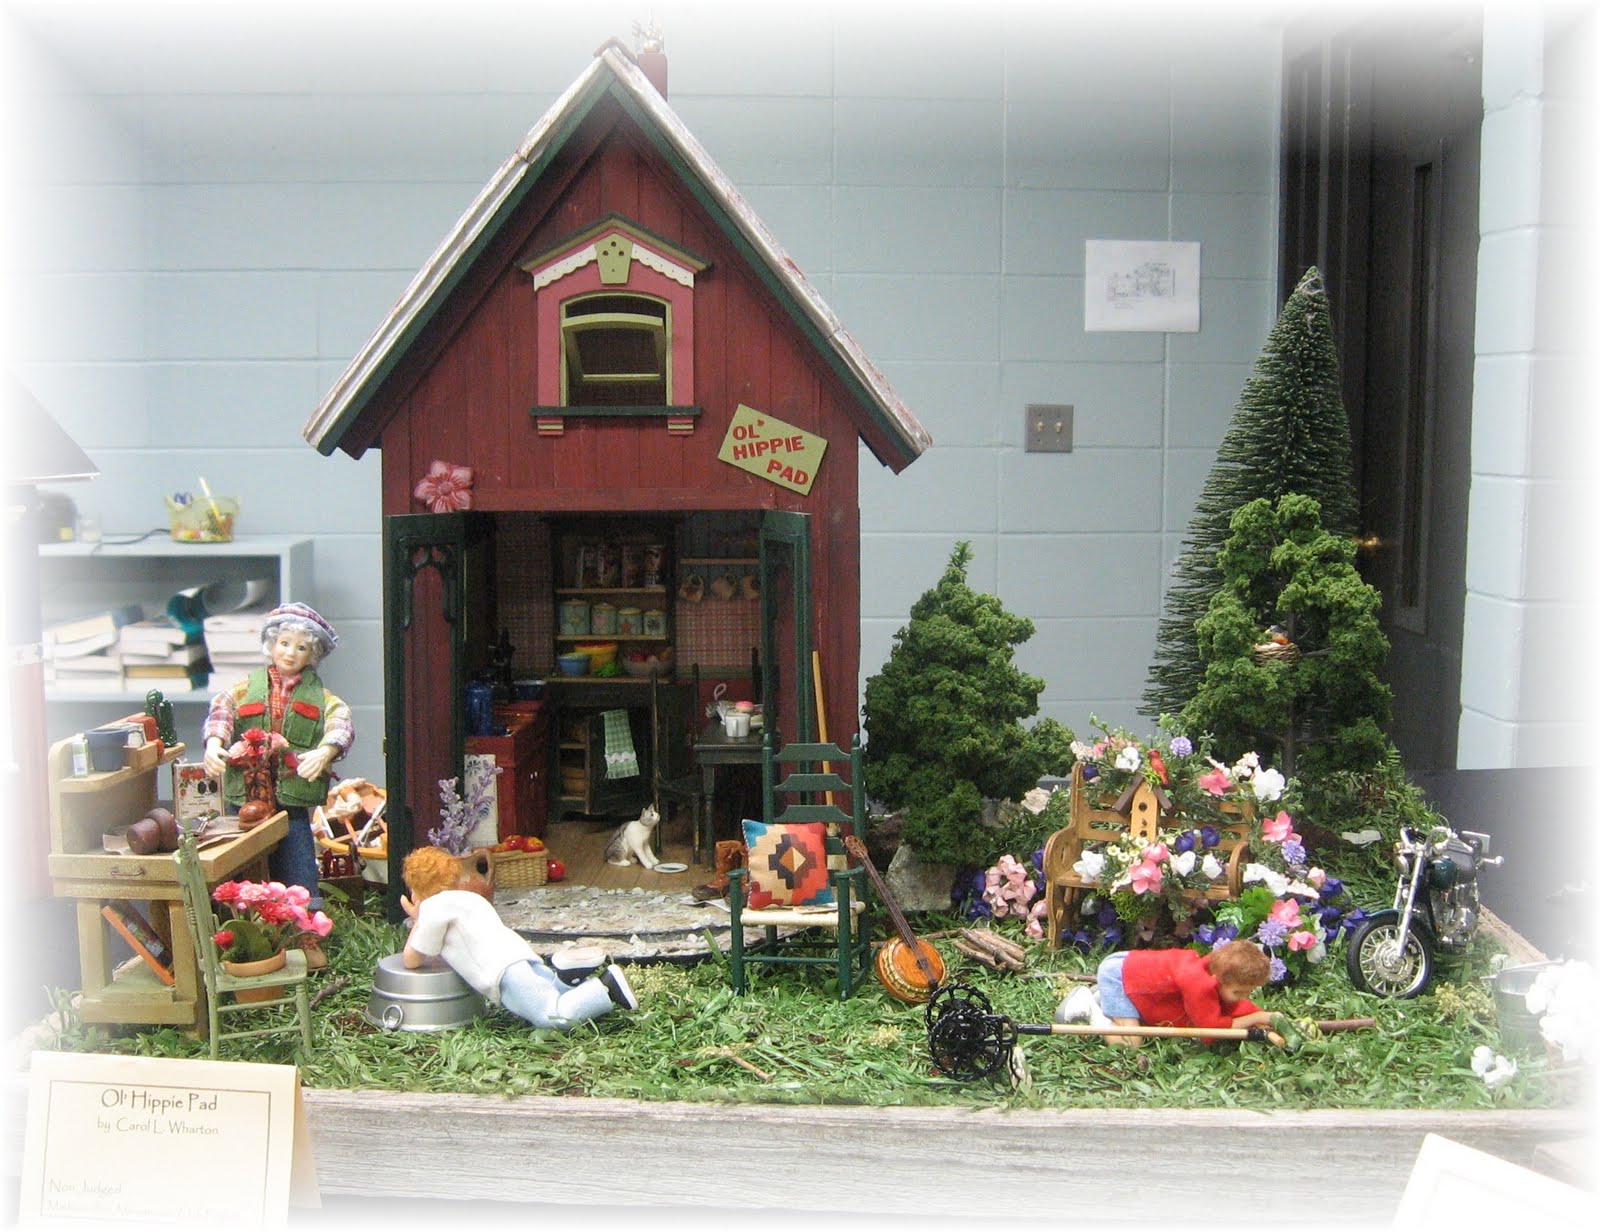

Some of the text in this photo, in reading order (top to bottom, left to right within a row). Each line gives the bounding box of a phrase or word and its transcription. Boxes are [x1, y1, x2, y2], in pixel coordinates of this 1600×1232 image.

[732, 435, 805, 460] HIPPIE
[766, 458, 809, 485] PAD
[131, 1090, 184, 1115] Hippie
[188, 1093, 218, 1112] Pad
[97, 1116, 111, 1133] by
[116, 1117, 151, 1132] Carol
[168, 1120, 219, 1135] Wharton
